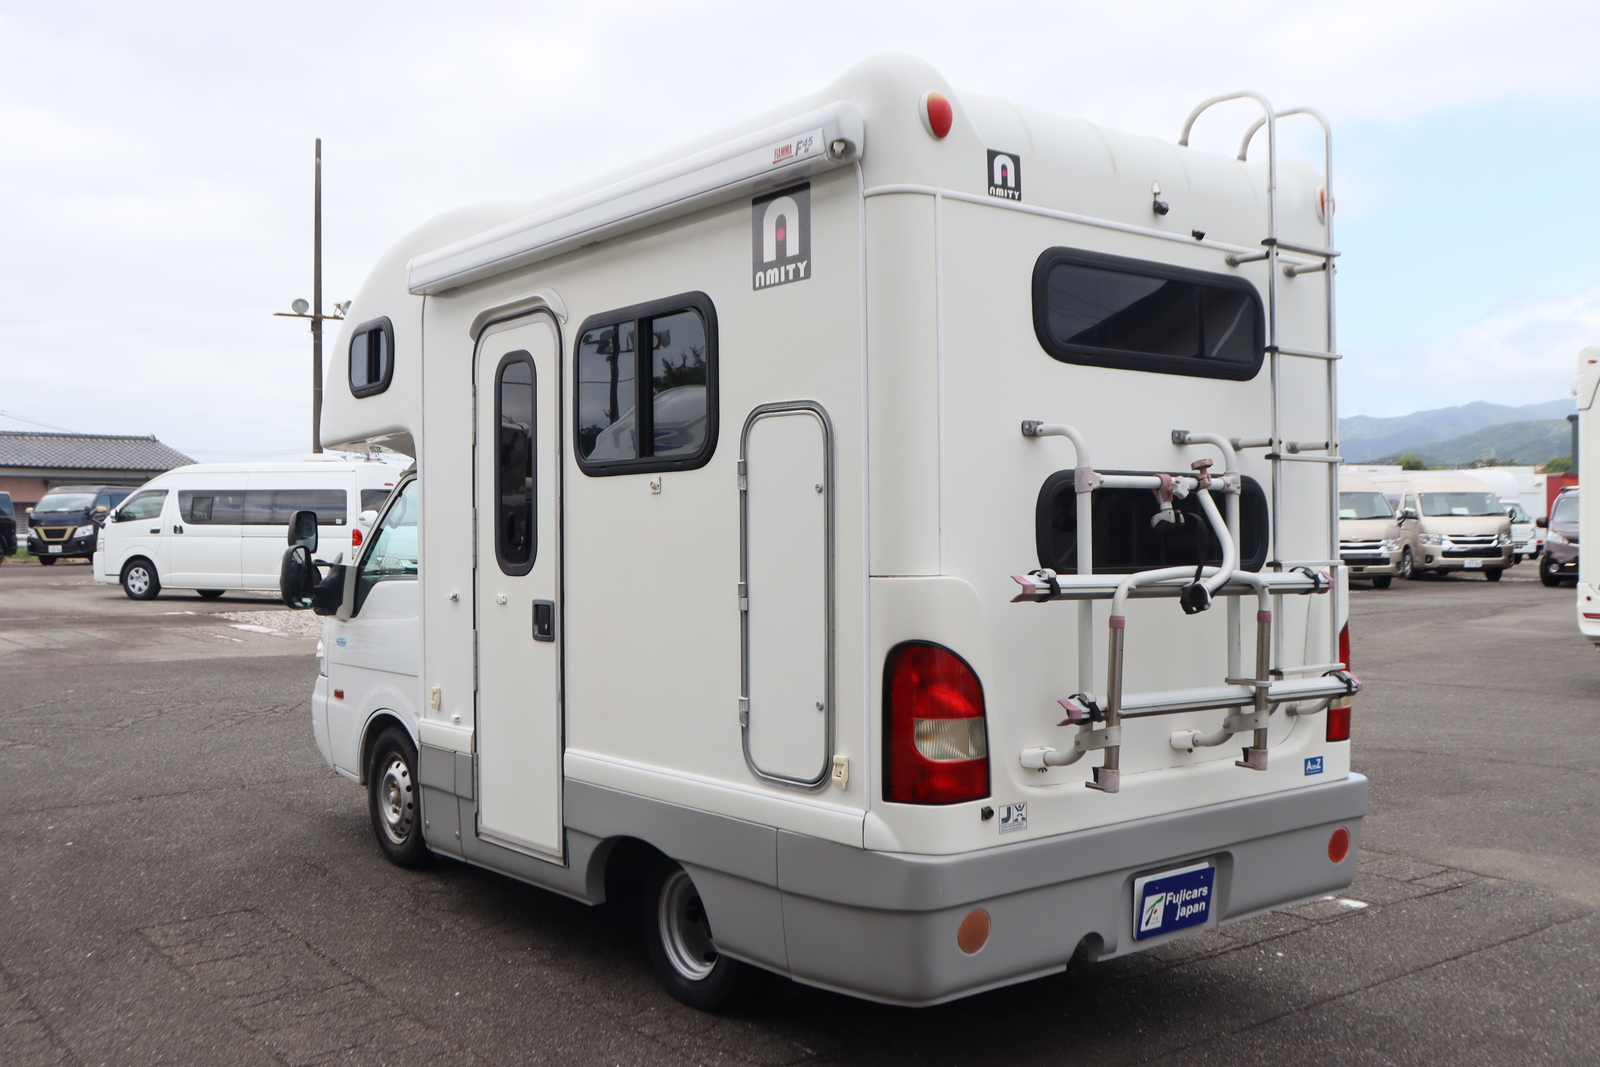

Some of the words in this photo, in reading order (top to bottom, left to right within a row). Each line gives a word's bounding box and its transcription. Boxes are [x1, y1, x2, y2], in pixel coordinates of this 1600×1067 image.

[989, 186, 1020, 200] AMITY
[755, 260, 808, 288] AMITY
[1166, 886, 1209, 906] Fujicars
[1175, 901, 1206, 921] japan
